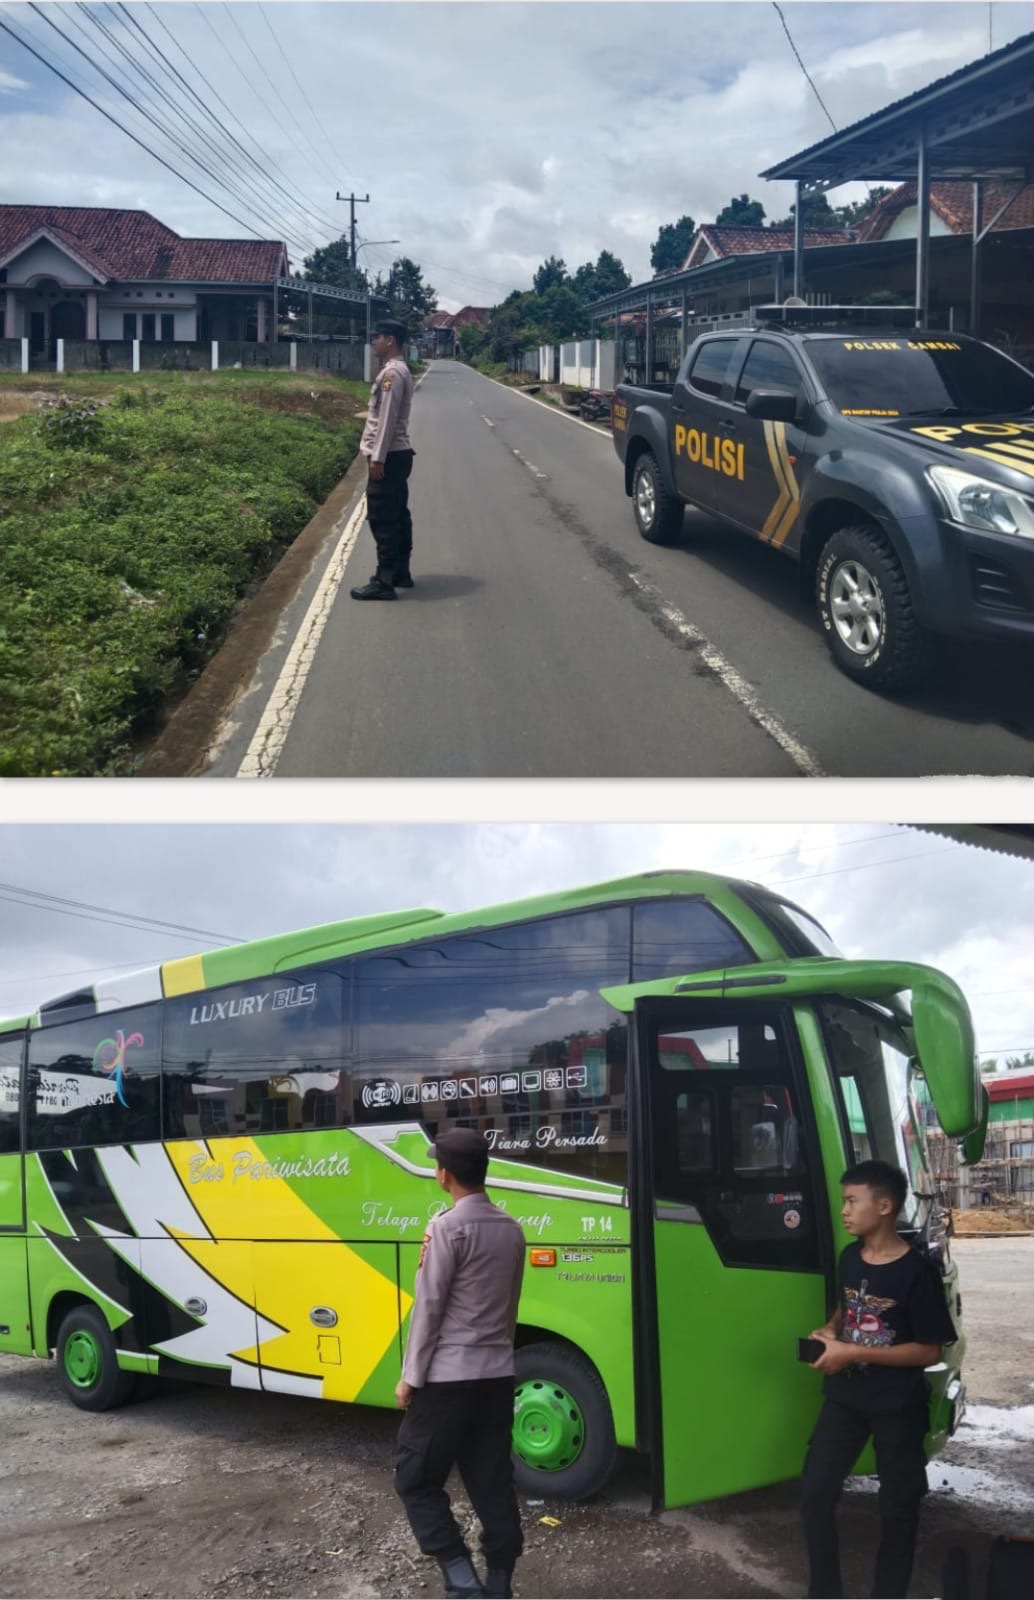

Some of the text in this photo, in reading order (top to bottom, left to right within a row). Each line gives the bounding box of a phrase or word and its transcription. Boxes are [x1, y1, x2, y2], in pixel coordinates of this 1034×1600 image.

[843, 342, 901, 351] POLSEK
[675, 424, 745, 481] POLISI
[190, 982, 317, 1025] LUXURY BUS
[483, 1126, 608, 1151] Tiara Persada
[188, 1151, 351, 1184] Bus Pariwisata
[360, 1201, 420, 1234] Telaga
[581, 1216, 612, 1232] TP 14
